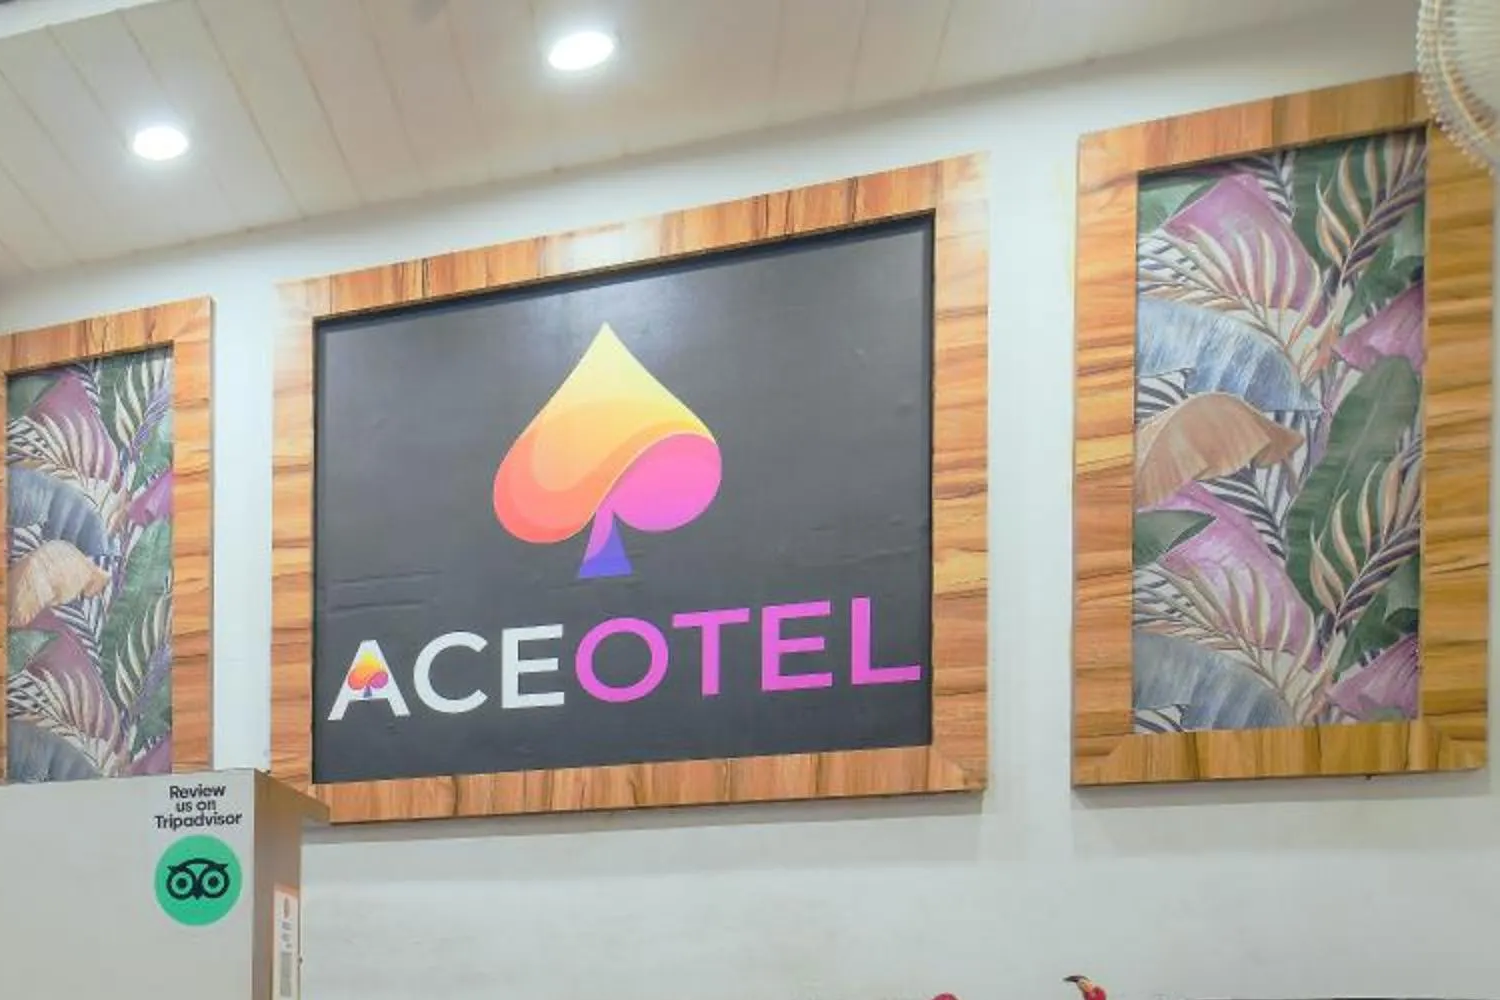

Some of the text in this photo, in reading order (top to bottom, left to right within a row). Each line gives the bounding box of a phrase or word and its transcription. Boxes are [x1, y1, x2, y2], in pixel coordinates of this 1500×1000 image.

[327, 596, 922, 721] ACEOTEL
[169, 784, 226, 799] Review
[176, 799, 216, 812] us on
[155, 812, 242, 830] Tripadvisor
